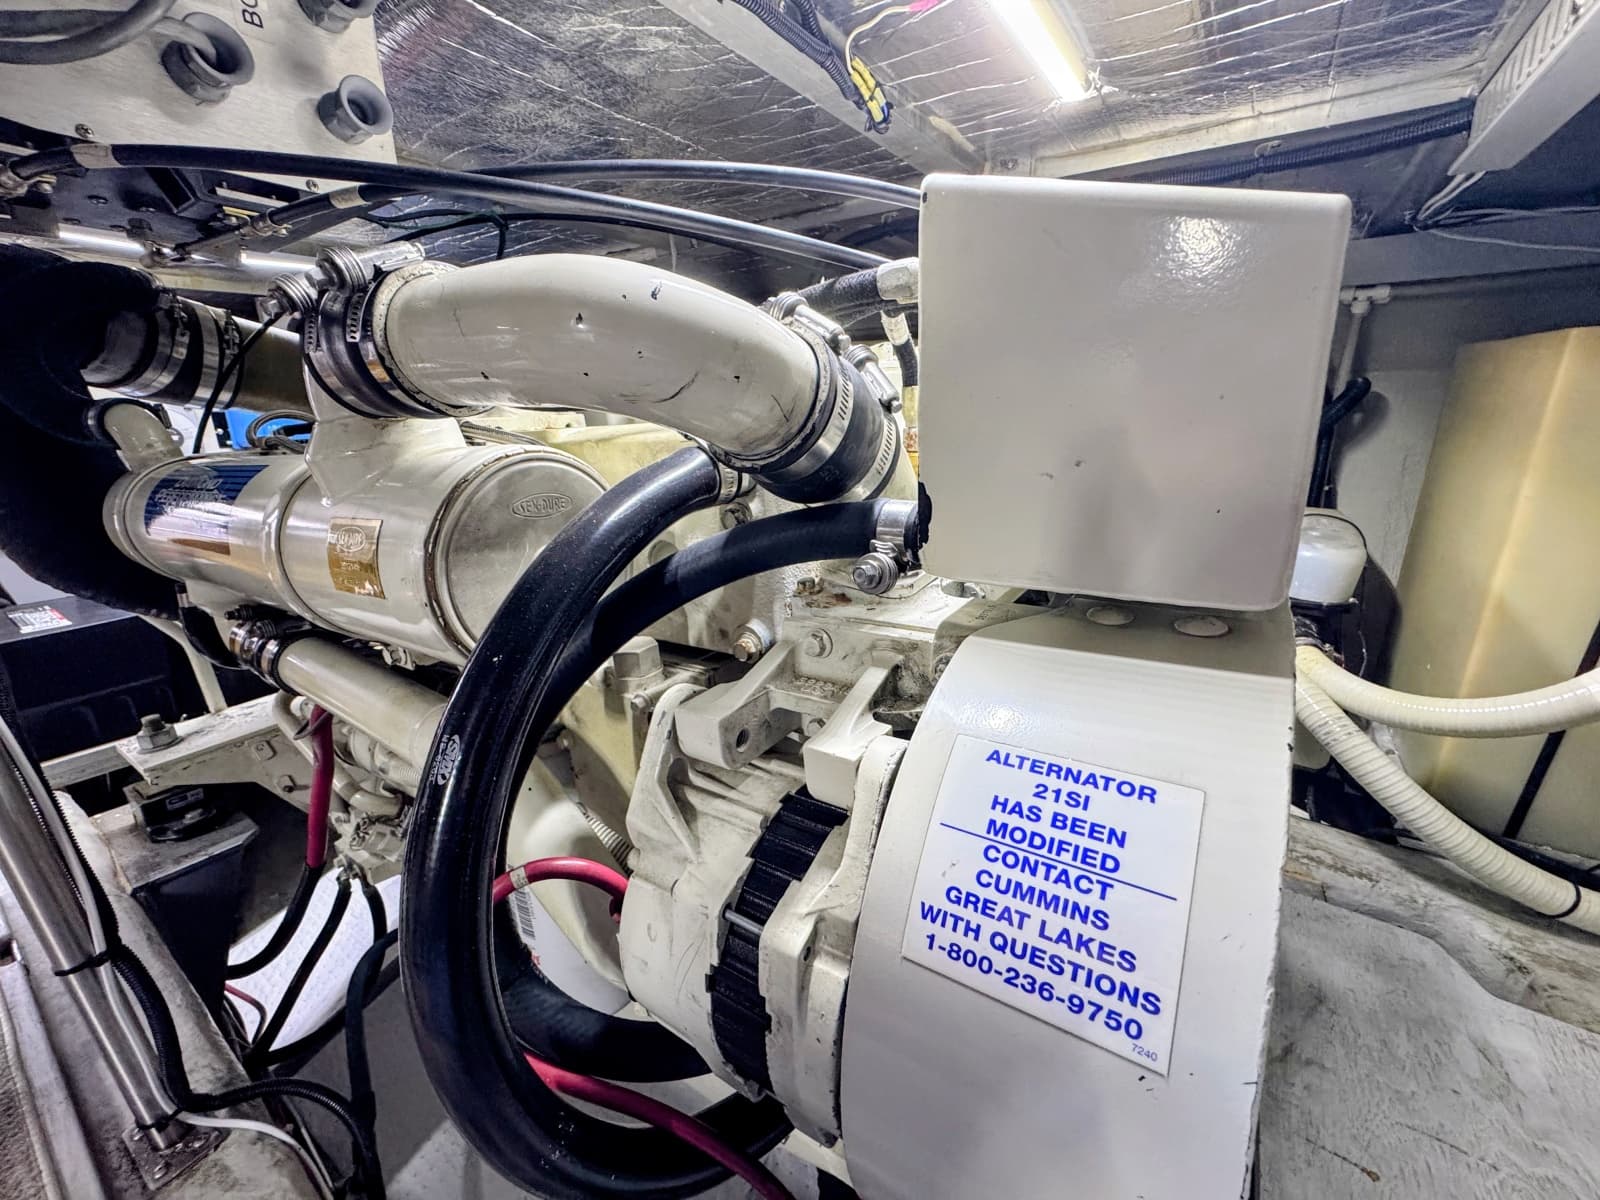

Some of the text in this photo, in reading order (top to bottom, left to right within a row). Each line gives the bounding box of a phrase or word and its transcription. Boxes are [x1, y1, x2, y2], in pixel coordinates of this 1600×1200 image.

[985, 749, 1157, 804] ALTERNATOR
[1032, 783, 1091, 812] 21SI
[985, 818, 1121, 874] MODIFIED
[990, 794, 1127, 849] HAS BEEN
[975, 868, 1110, 931] CUMMINS
[982, 844, 1114, 901] CONTACT
[945, 885, 1137, 973] GREAT LAKES
[920, 901, 1162, 1016] WITH QUESTIONS
[925, 933, 1143, 1041] 1-800-236-9750
[1131, 1042, 1159, 1062] 7240
